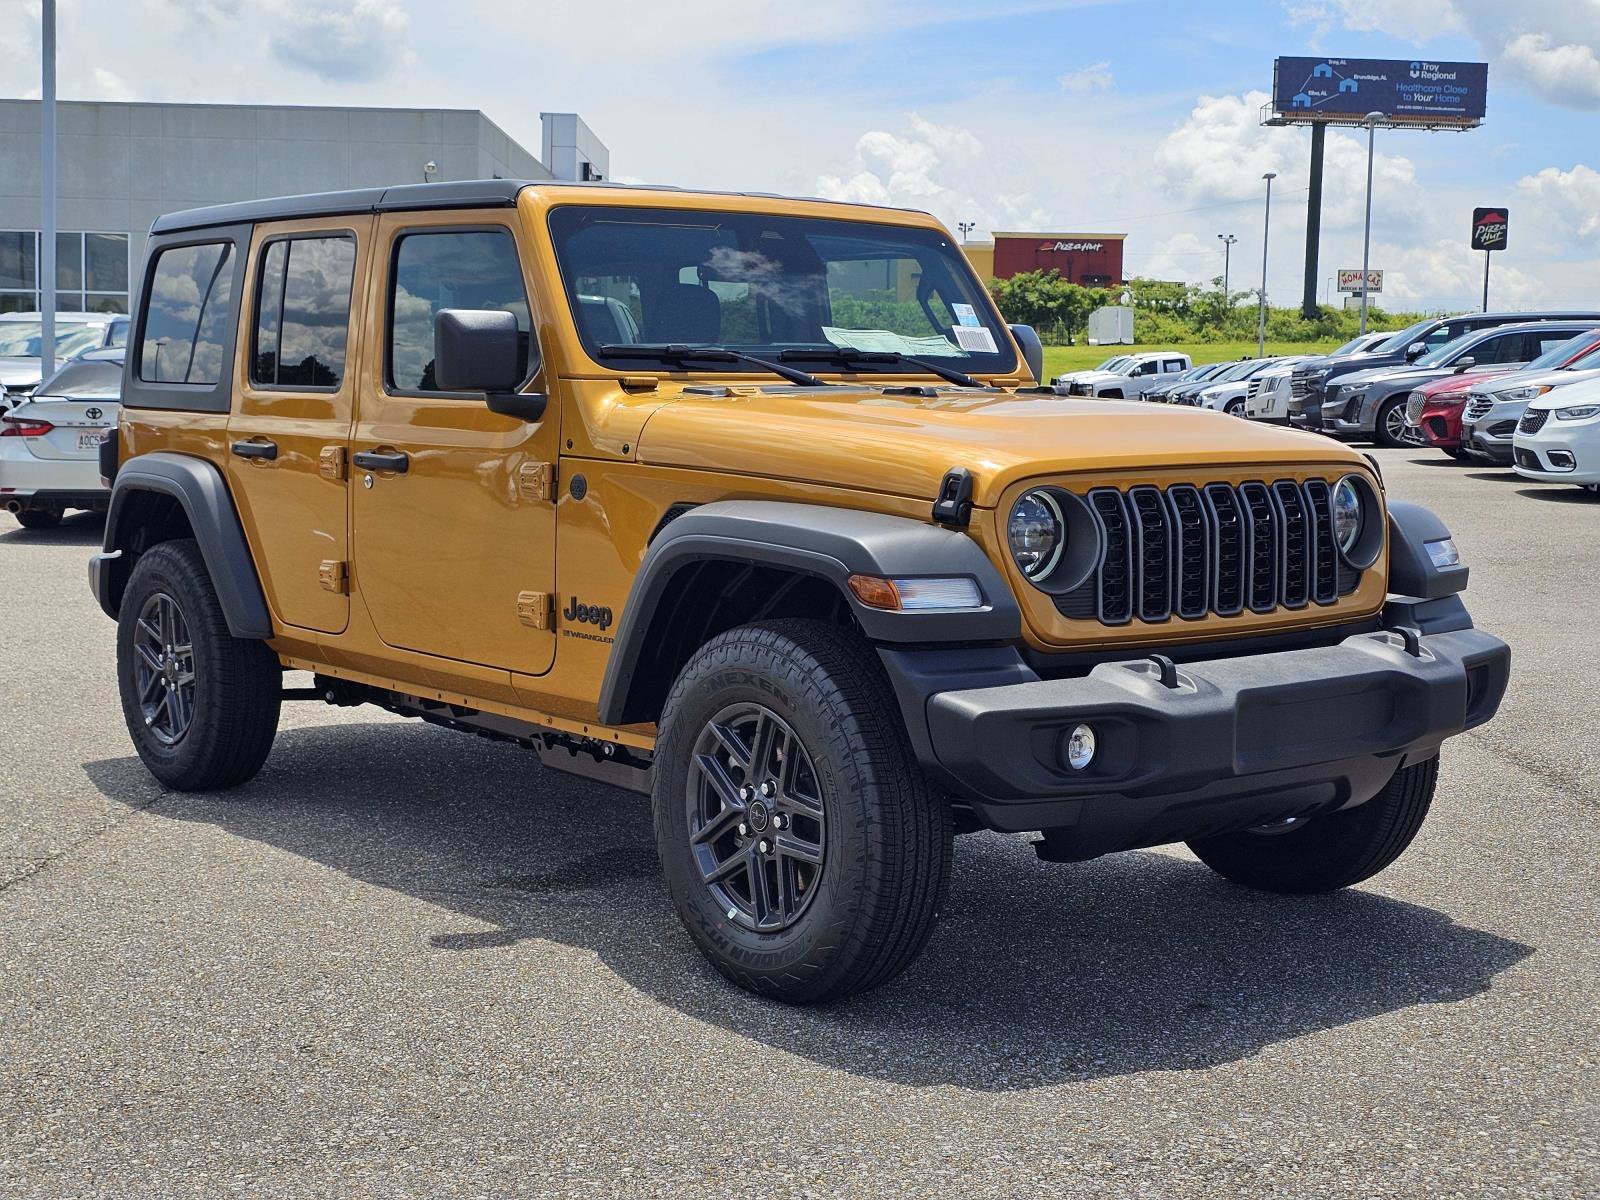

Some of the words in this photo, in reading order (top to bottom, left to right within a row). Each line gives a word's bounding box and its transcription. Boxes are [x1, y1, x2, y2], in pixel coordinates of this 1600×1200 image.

[1422, 63, 1440, 72] Troy
[1421, 71, 1457, 81] Regional
[1396, 83, 1442, 93] Healthcare
[1443, 85, 1468, 95] Close
[1403, 93, 1412, 101] to
[1413, 93, 1434, 102] Your
[1435, 94, 1461, 103] Home
[1475, 223, 1507, 239] Pizza
[1480, 230, 1504, 243] Hut
[1053, 241, 1081, 252] Pizza
[1080, 242, 1104, 252] Hut
[1341, 272, 1381, 286] MONACAS
[563, 596, 613, 631] Jeep
[570, 630, 614, 644] WRANGLER
[710, 671, 789, 707] NEXEN
